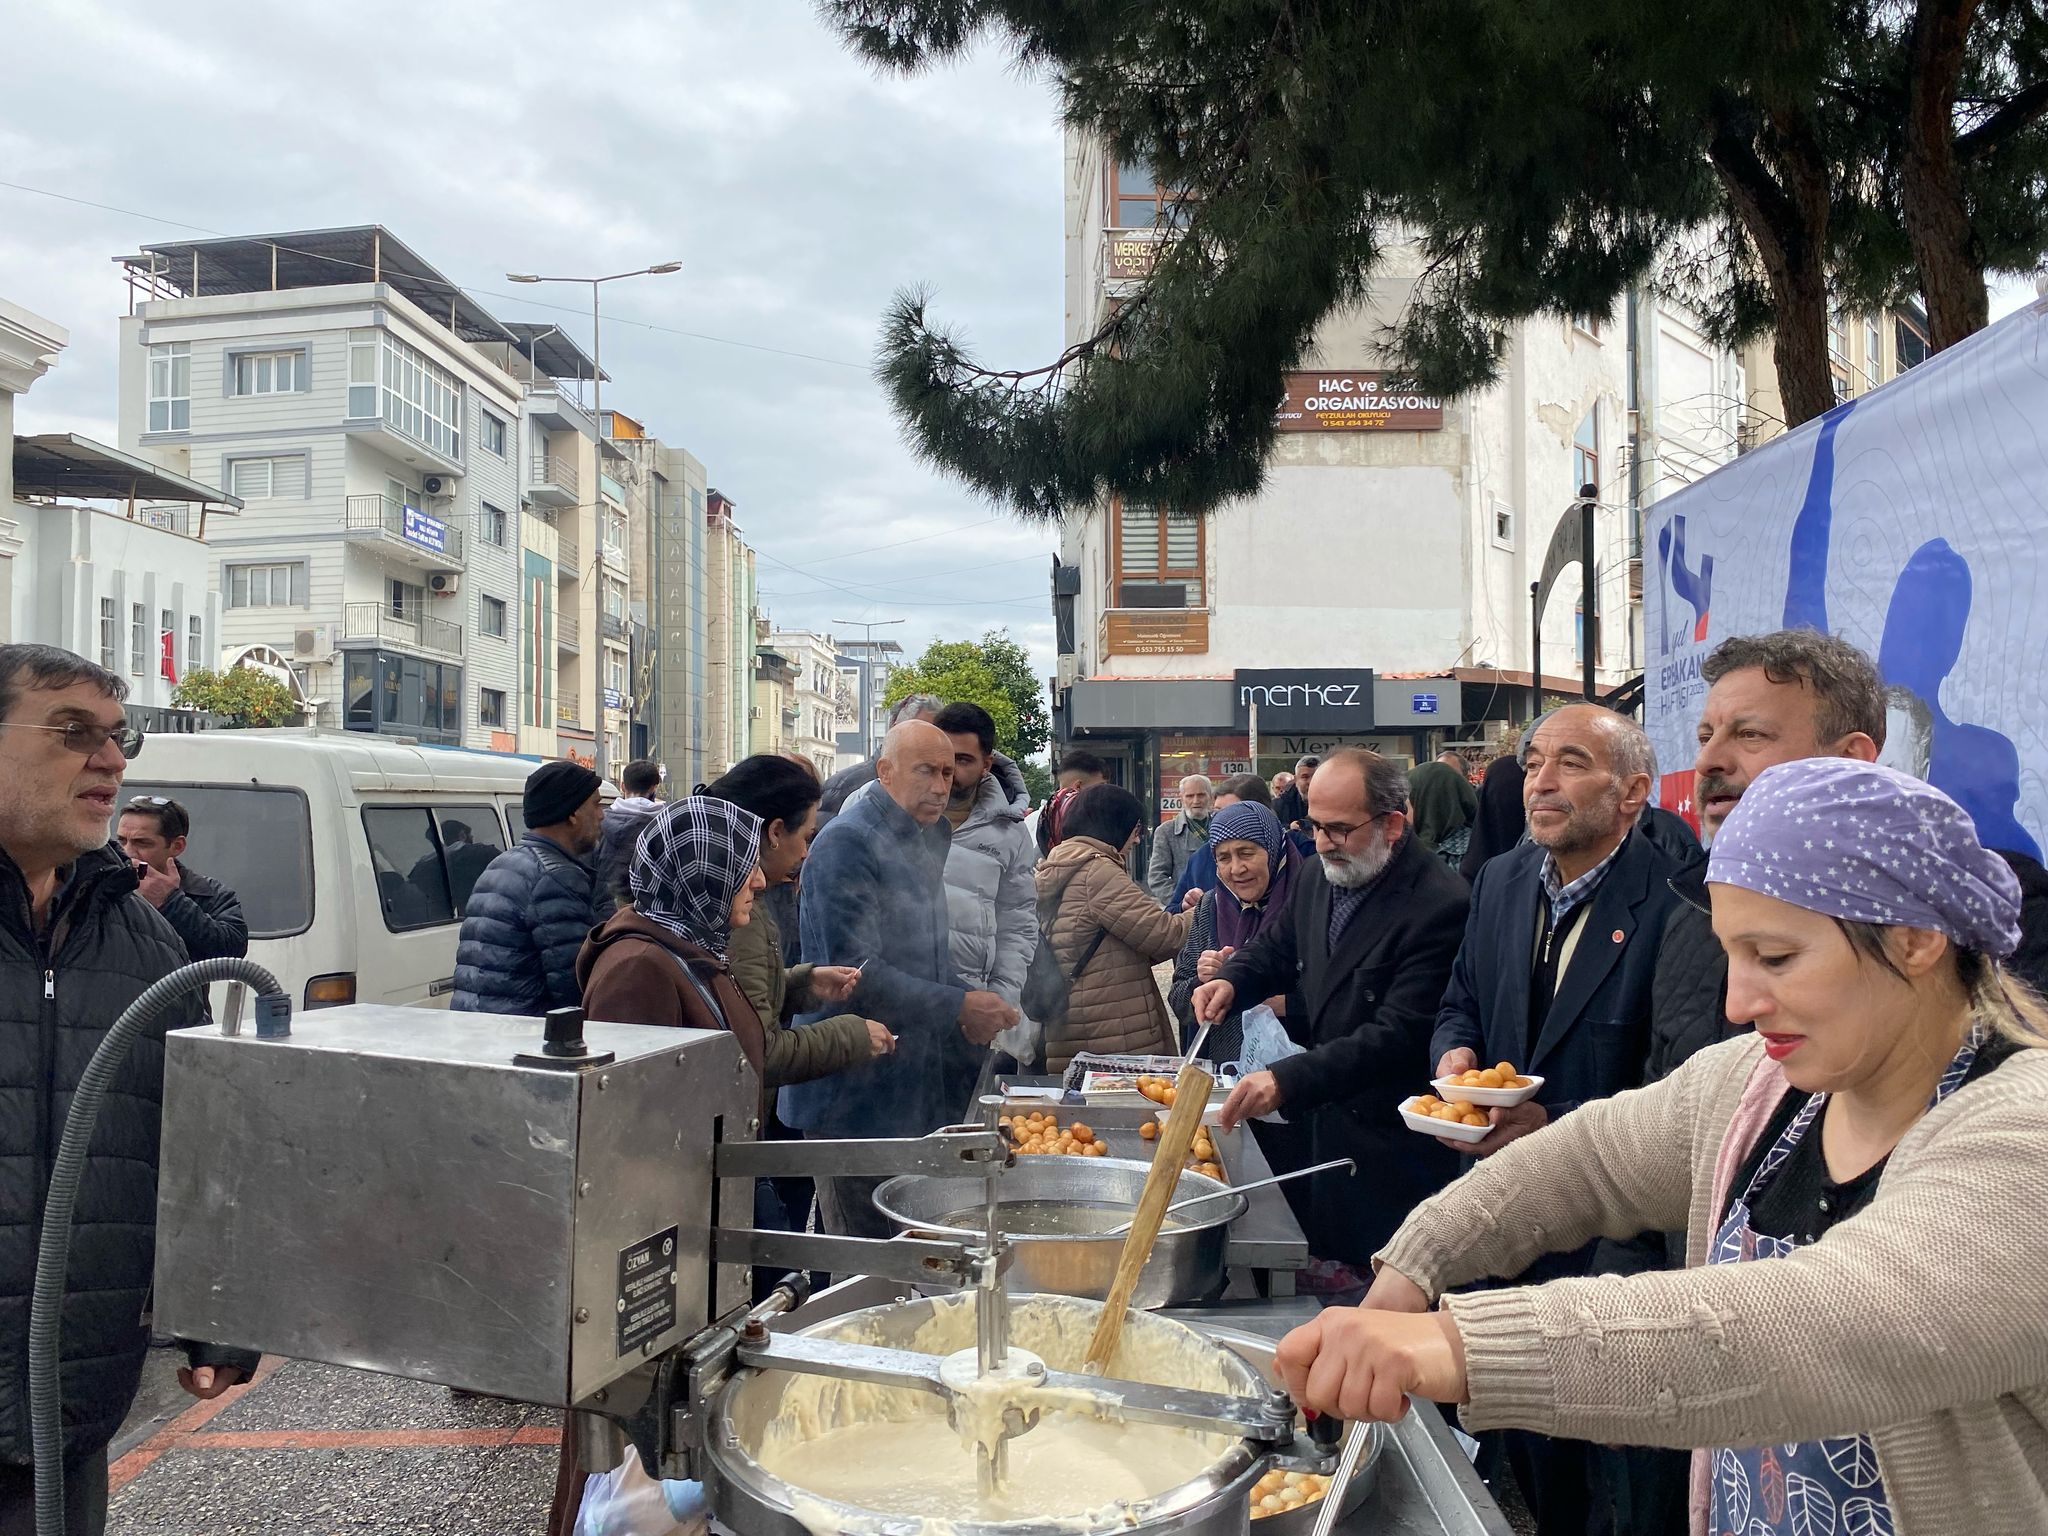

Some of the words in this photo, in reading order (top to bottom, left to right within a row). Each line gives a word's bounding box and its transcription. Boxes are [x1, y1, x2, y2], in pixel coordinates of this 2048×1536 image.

[1319, 379, 1353, 392] HAC
[1358, 382, 1377, 392] ve
[1304, 394, 1441, 410] ORGANİZASYONU
[1661, 652, 1705, 691] ERBAKAN
[1240, 683, 1361, 707] merkez
[1283, 737, 1382, 754] Merez
[1223, 763, 1244, 774] 130
[1163, 799, 1182, 809] 260
